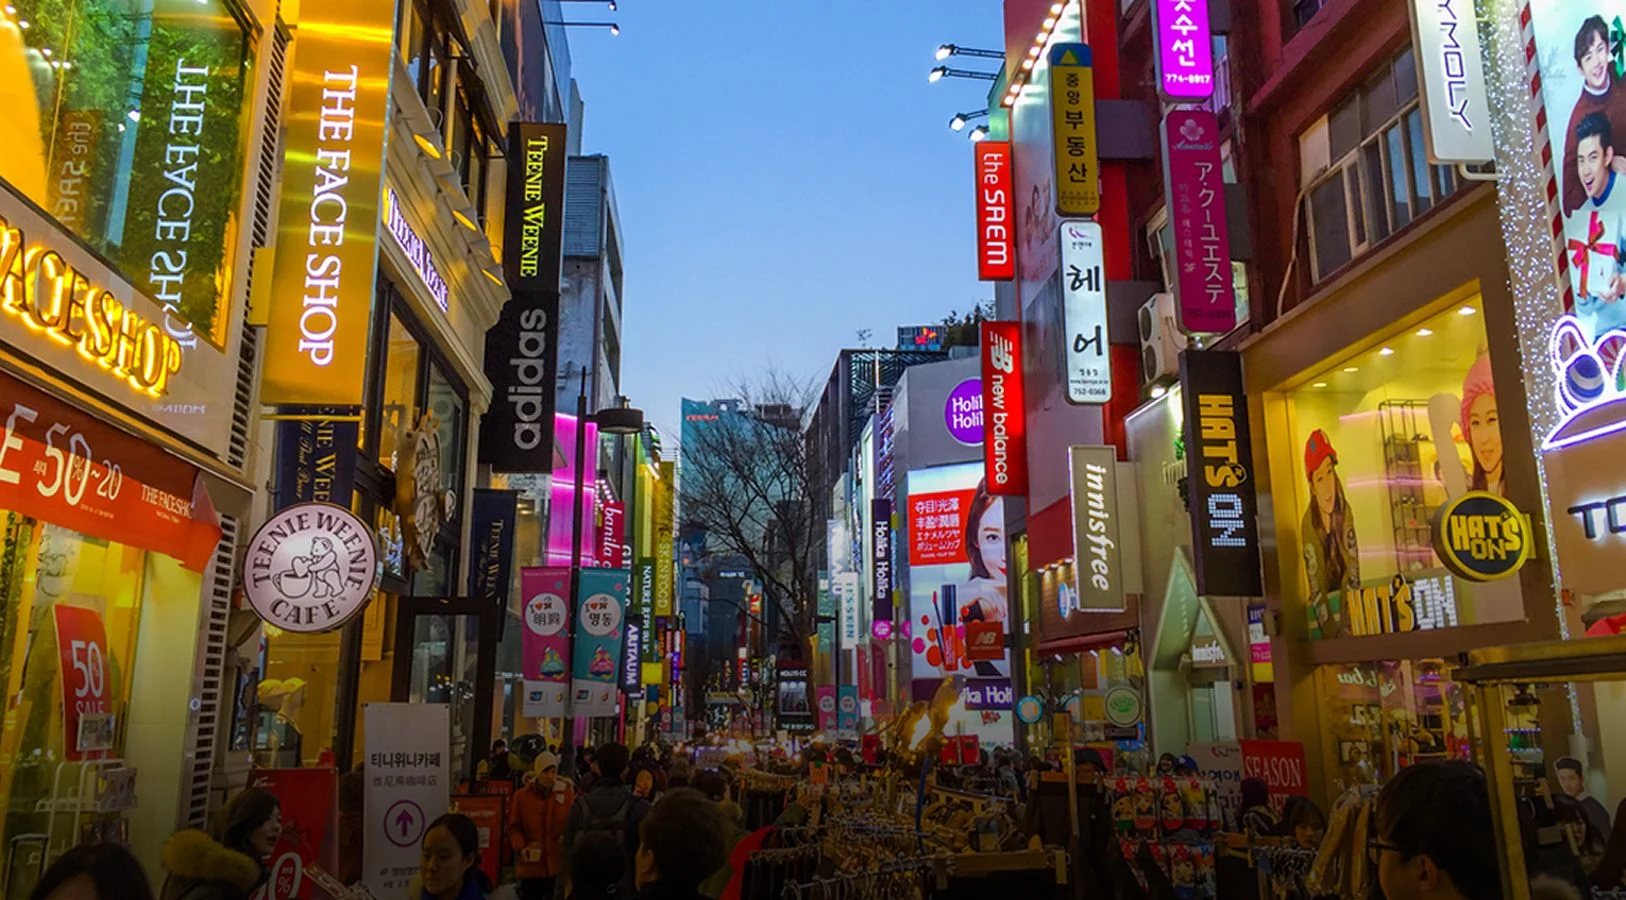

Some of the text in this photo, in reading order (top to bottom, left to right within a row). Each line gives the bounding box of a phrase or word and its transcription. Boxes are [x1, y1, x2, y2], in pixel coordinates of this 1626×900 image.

[1065, 110, 1087, 183] 부동산
[298, 65, 358, 367] THE FACE SHOP
[520, 136, 548, 278] TEENIE WEENIE
[983, 153, 1008, 265] the SAEM
[507, 308, 547, 451] adidas
[992, 375, 1005, 409] new
[993, 413, 1009, 484] balance
[141, 484, 159, 505] THE
[1208, 493, 1246, 547] ON
[252, 511, 369, 592] TEENIE WEENIE
[603, 507, 623, 557] banila
[1086, 463, 1115, 592] innisfree
[1470, 536, 1507, 561] ON
[641, 565, 652, 603] NATURE
[875, 521, 890, 600] Holika Holika
[269, 598, 341, 625] CAFE
[588, 612, 613, 628] 명동
[1412, 576, 1458, 630] ON
[71, 640, 104, 698] 50
[625, 624, 639, 686] ARITAUM
[370, 752, 441, 769] 티니위니카페
[1244, 755, 1302, 787] SEASON
